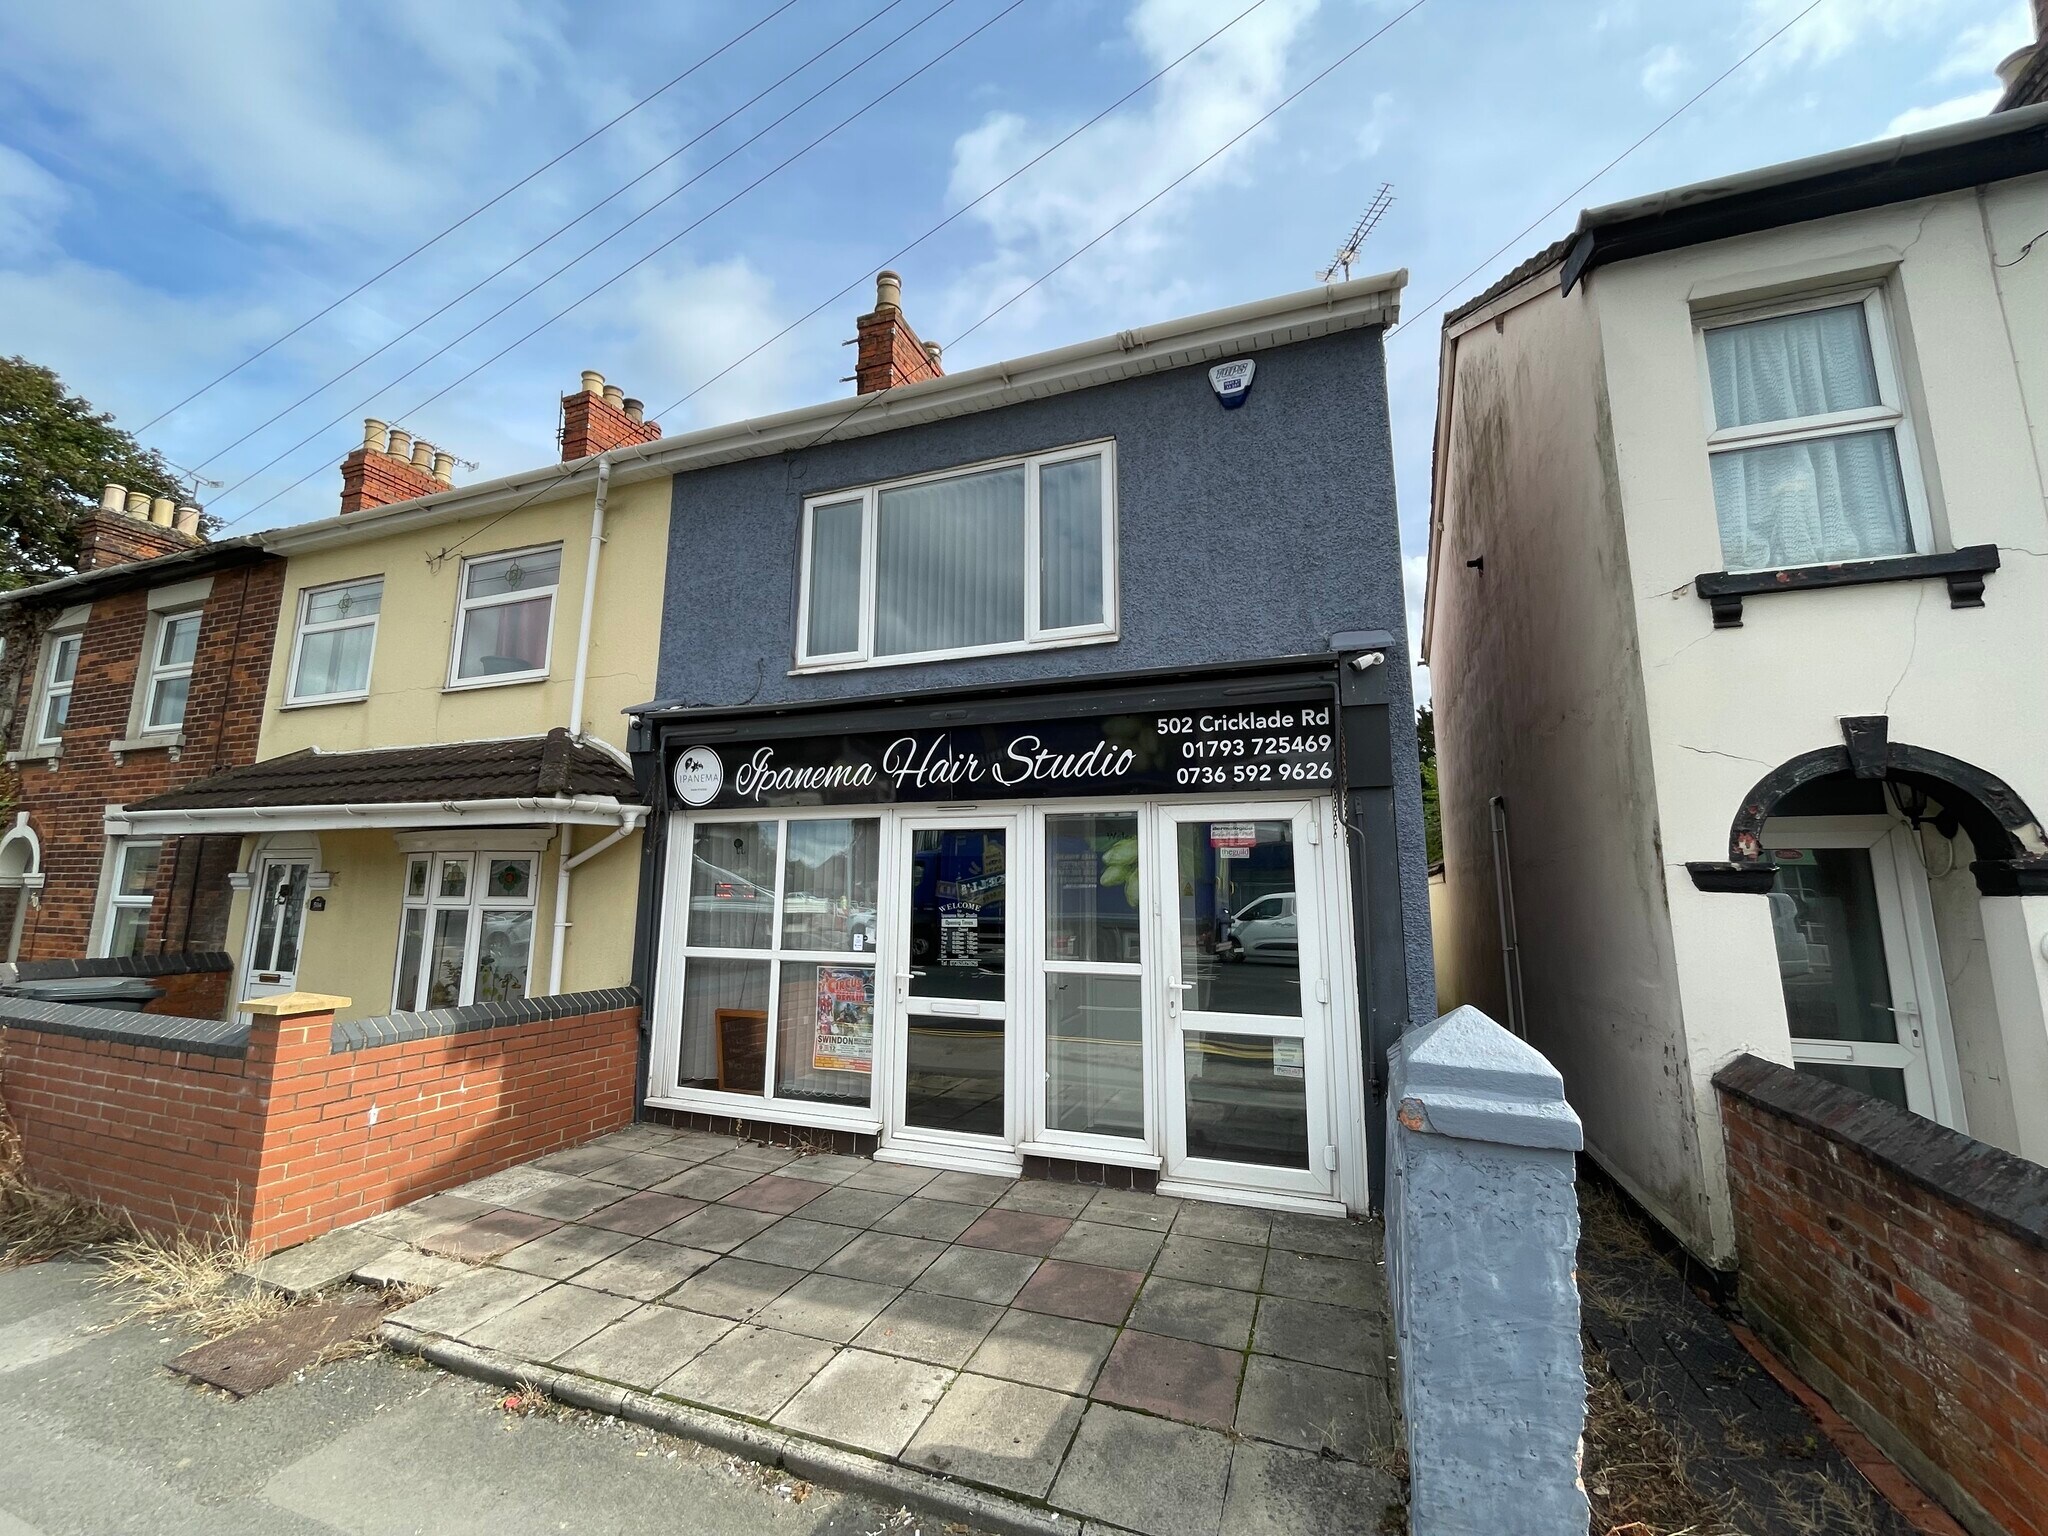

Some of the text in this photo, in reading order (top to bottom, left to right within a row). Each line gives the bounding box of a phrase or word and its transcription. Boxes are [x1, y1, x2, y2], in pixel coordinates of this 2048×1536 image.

[1157, 707, 1330, 735] 502 Cricklade Rd
[1182, 734, 1332, 759] 01793 725469
[735, 733, 1137, 802] Ipanema Hair Studio
[1177, 762, 1333, 785] 0736 592 9626
[679, 774, 720, 783] IPANEMA
[938, 901, 981, 912] WELCOME
[827, 977, 863, 993] CIRCUS
[817, 1034, 855, 1045] SWINDON
